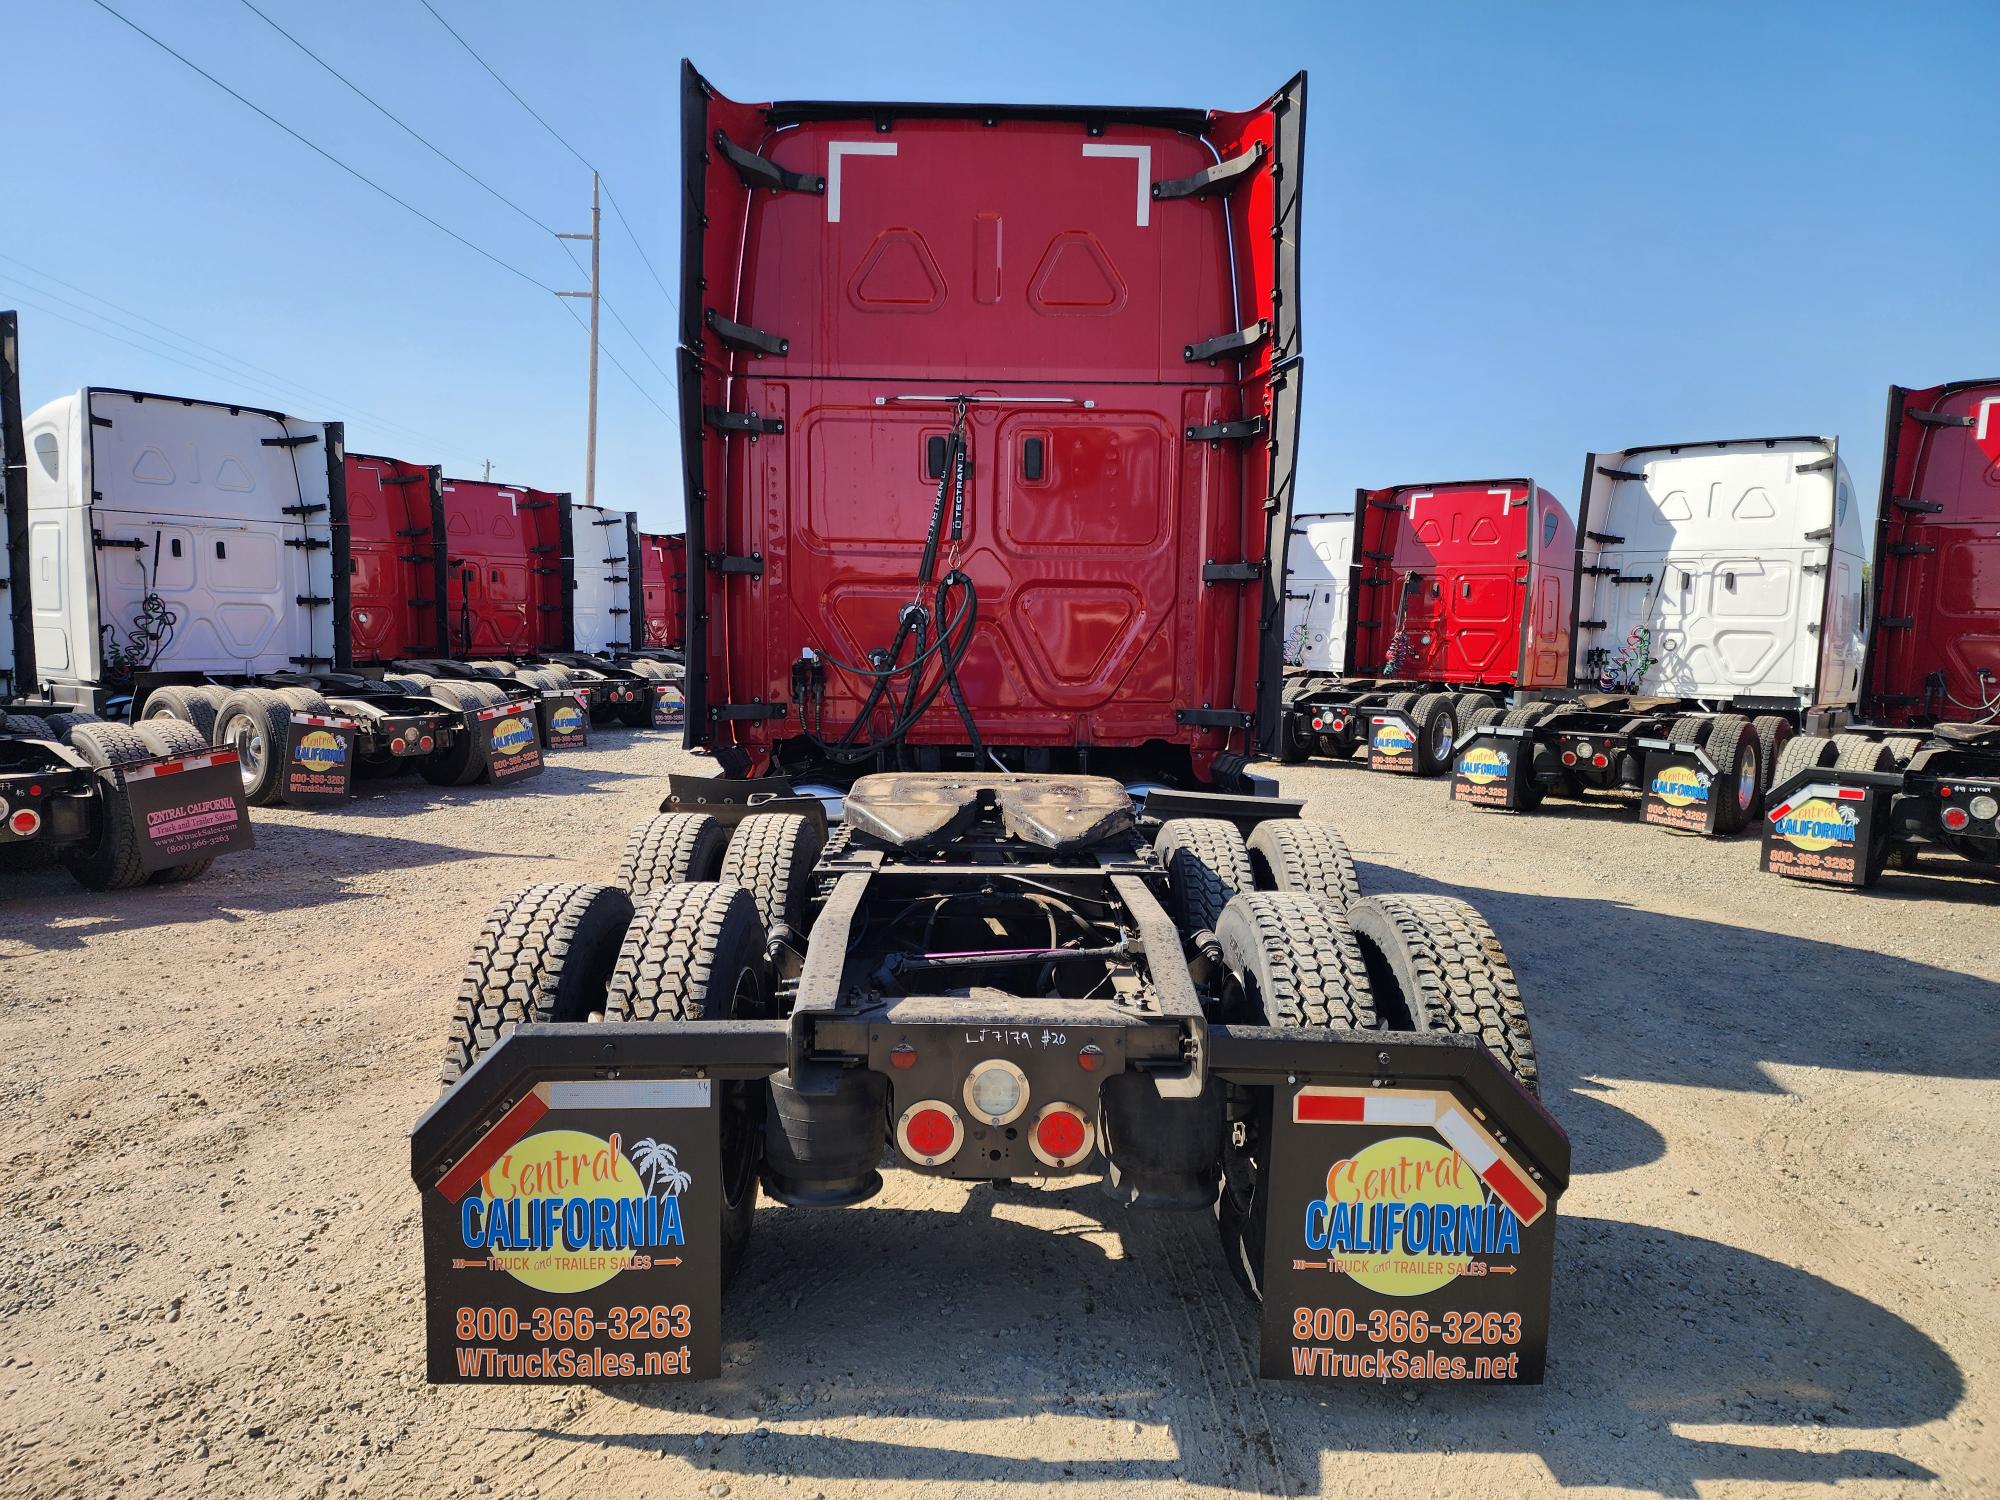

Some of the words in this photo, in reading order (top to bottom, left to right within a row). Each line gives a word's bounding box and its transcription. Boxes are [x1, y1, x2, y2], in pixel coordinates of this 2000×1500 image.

[956, 464, 964, 517] TECTRAN
[490, 726, 534, 750] CALIFORNIA
[295, 746, 345, 762] CALIFORNIA
[1459, 760, 1508, 777] CALIFORNIA
[1652, 779, 1708, 800] CALIFORNIA
[147, 807, 187, 826] CENTRAL
[187, 796, 236, 815] CALIFORNIA
[1648, 804, 1707, 822] 800-366-3263
[156, 823, 177, 835] Truck
[178, 821, 190, 829] and
[192, 816, 213, 827] Trailer
[215, 813, 231, 822] Sales
[1775, 818, 1856, 841] CALIFORNIA
[167, 842, 191, 855] (800)
[192, 835, 230, 850] 366-3263
[1770, 849, 1855, 871] 800-366-3263
[1769, 862, 1853, 882] WTruckSales.net
[1040, 1028, 1067, 1050] #20
[480, 1132, 623, 1203] Central
[1326, 1150, 1465, 1207] Central
[461, 1195, 685, 1250] CALIFORNIA
[1305, 1200, 1521, 1254] CALIFORNIA
[486, 1256, 529, 1271] TRUCK
[533, 1254, 551, 1271] and
[555, 1257, 608, 1271] TRAILER
[610, 1255, 652, 1271] SALES
[1327, 1258, 1369, 1273] TRUCK
[1373, 1258, 1391, 1274] and
[1393, 1260, 1443, 1275] TRAILER
[1447, 1261, 1487, 1277] SALES
[456, 1305, 691, 1341] 800-366-3263
[1293, 1307, 1522, 1345] 800-366-3263
[456, 1345, 691, 1378] WTruckSales.net
[1292, 1347, 1519, 1380] WTruckSales.net
